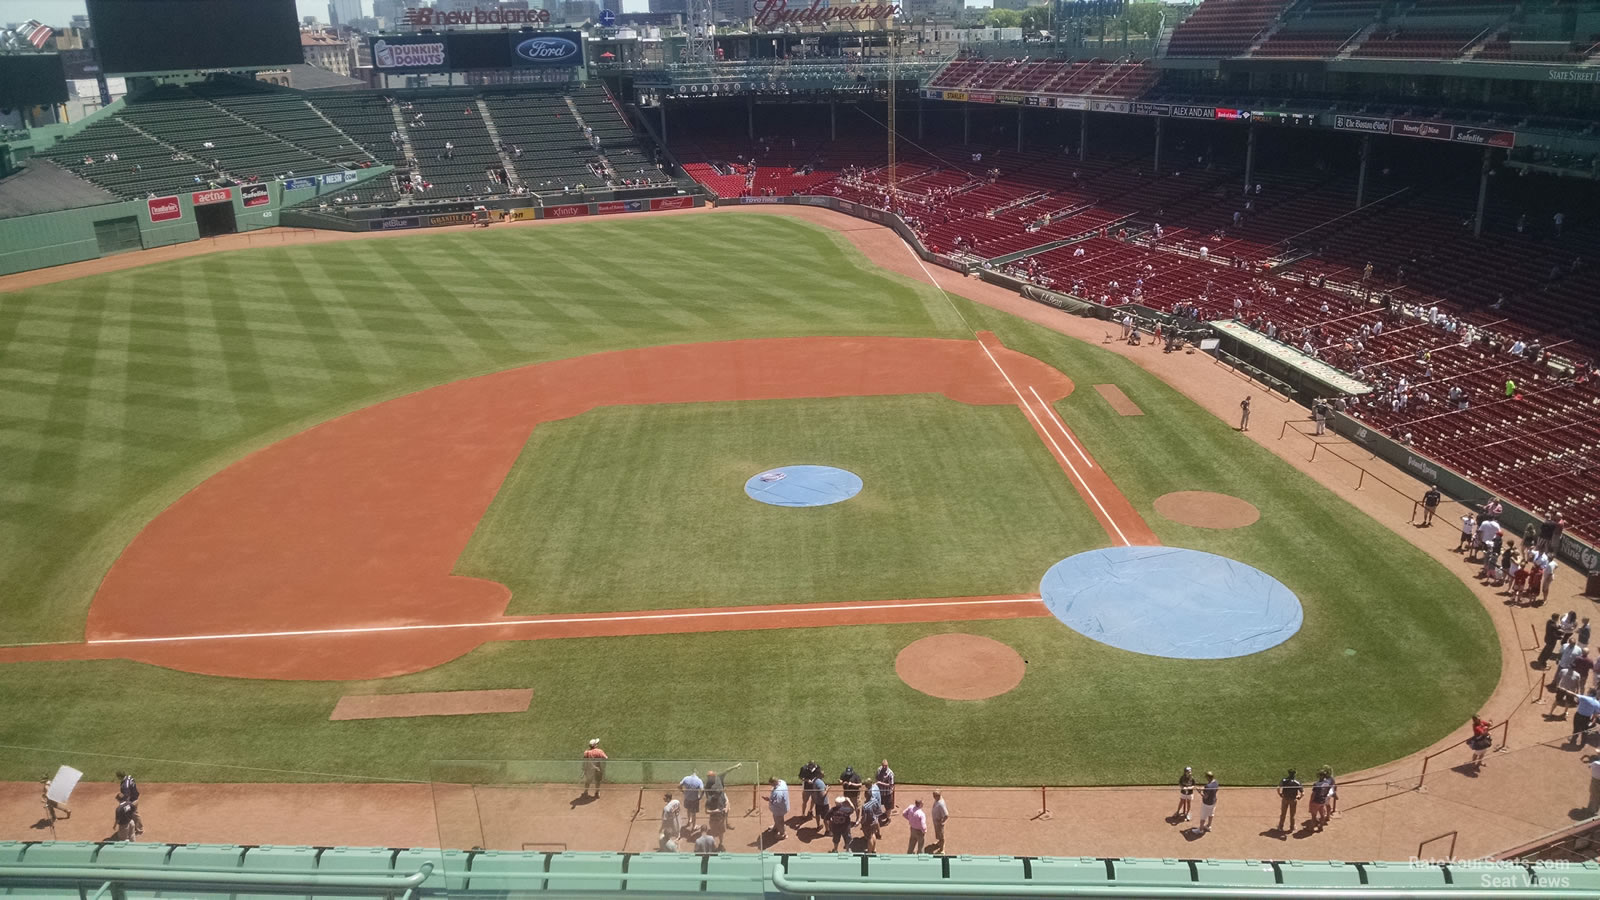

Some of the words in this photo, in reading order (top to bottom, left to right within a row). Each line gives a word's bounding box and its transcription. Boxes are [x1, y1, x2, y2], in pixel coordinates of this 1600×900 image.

[435, 10, 473, 25] new
[474, 6, 550, 24] balance
[754, 0, 901, 27] Budweiser
[395, 44, 443, 55] DUNKIN'
[528, 40, 565, 58] Ford
[396, 54, 442, 65] DONUTS
[1548, 69, 1568, 80] STATE
[1569, 70, 1594, 81] STREET
[1173, 108, 1187, 116] ALEX
[1189, 109, 1202, 117] AND
[1203, 109, 1214, 118] ANI
[1345, 118, 1354, 128] The
[1355, 119, 1373, 130] Boston
[1372, 121, 1388, 131] Globe
[1403, 124, 1419, 133] Ninety
[1427, 127, 1439, 135] Nine
[1456, 132, 1484, 143] Safelite
[198, 190, 226, 202] aetna
[242, 190, 268, 199] Safelite
[499, 212, 524, 220] Non
[553, 207, 579, 217] xfinity
[382, 218, 408, 229] jetBlue
[430, 214, 459, 225] GRANITE
[1562, 534, 1583, 552] Ninety
[1562, 543, 1581, 561] Nine
